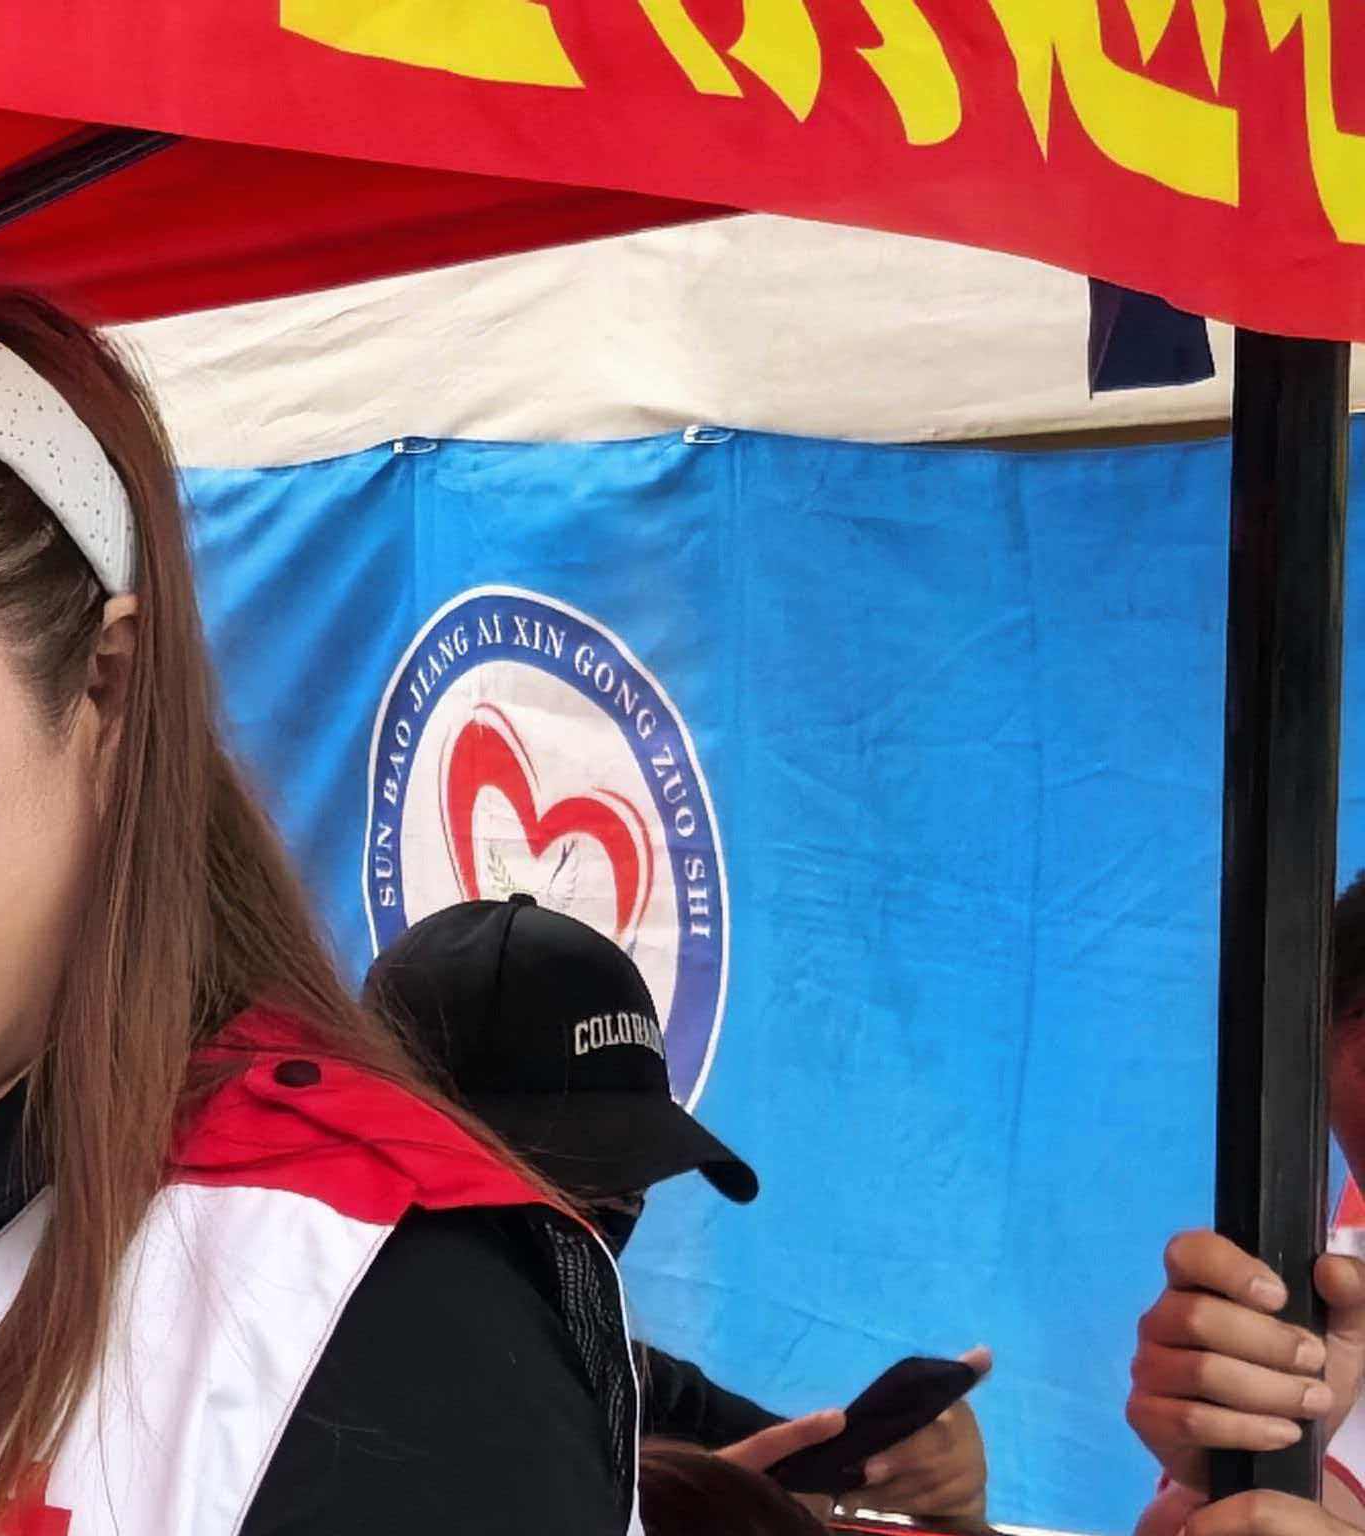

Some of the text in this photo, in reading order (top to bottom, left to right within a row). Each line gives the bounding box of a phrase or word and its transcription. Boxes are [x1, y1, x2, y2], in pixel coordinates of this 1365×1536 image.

[374, 612, 711, 938] SUN BAO JIANG AI XIN GONG ZUO SHI
